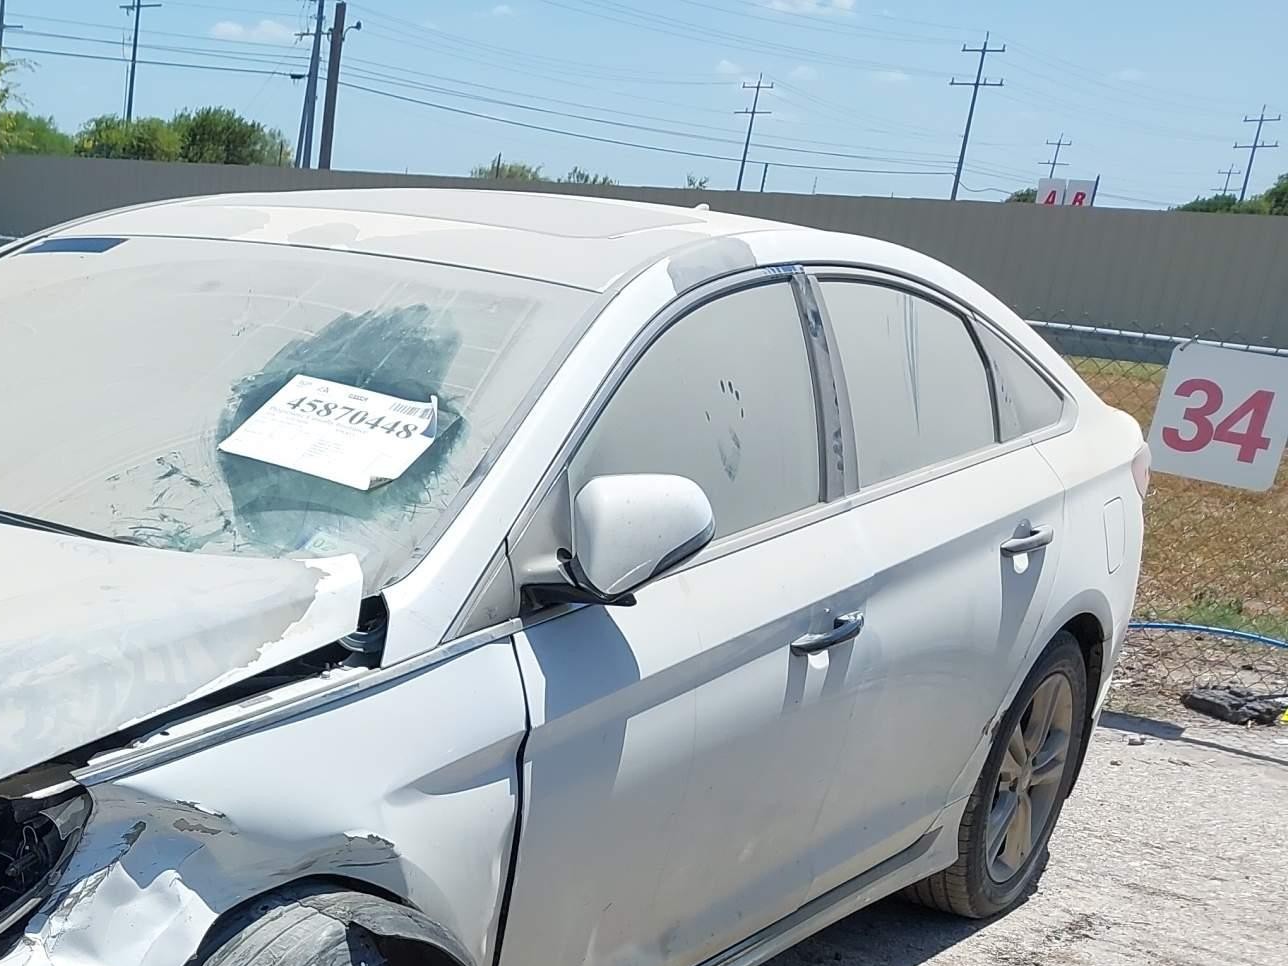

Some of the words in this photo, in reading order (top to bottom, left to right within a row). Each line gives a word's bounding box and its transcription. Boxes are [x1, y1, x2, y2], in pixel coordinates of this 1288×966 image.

[1044, 190, 1057, 205] A
[287, 396, 418, 439] 45870448
[1162, 378, 1275, 464] 34
